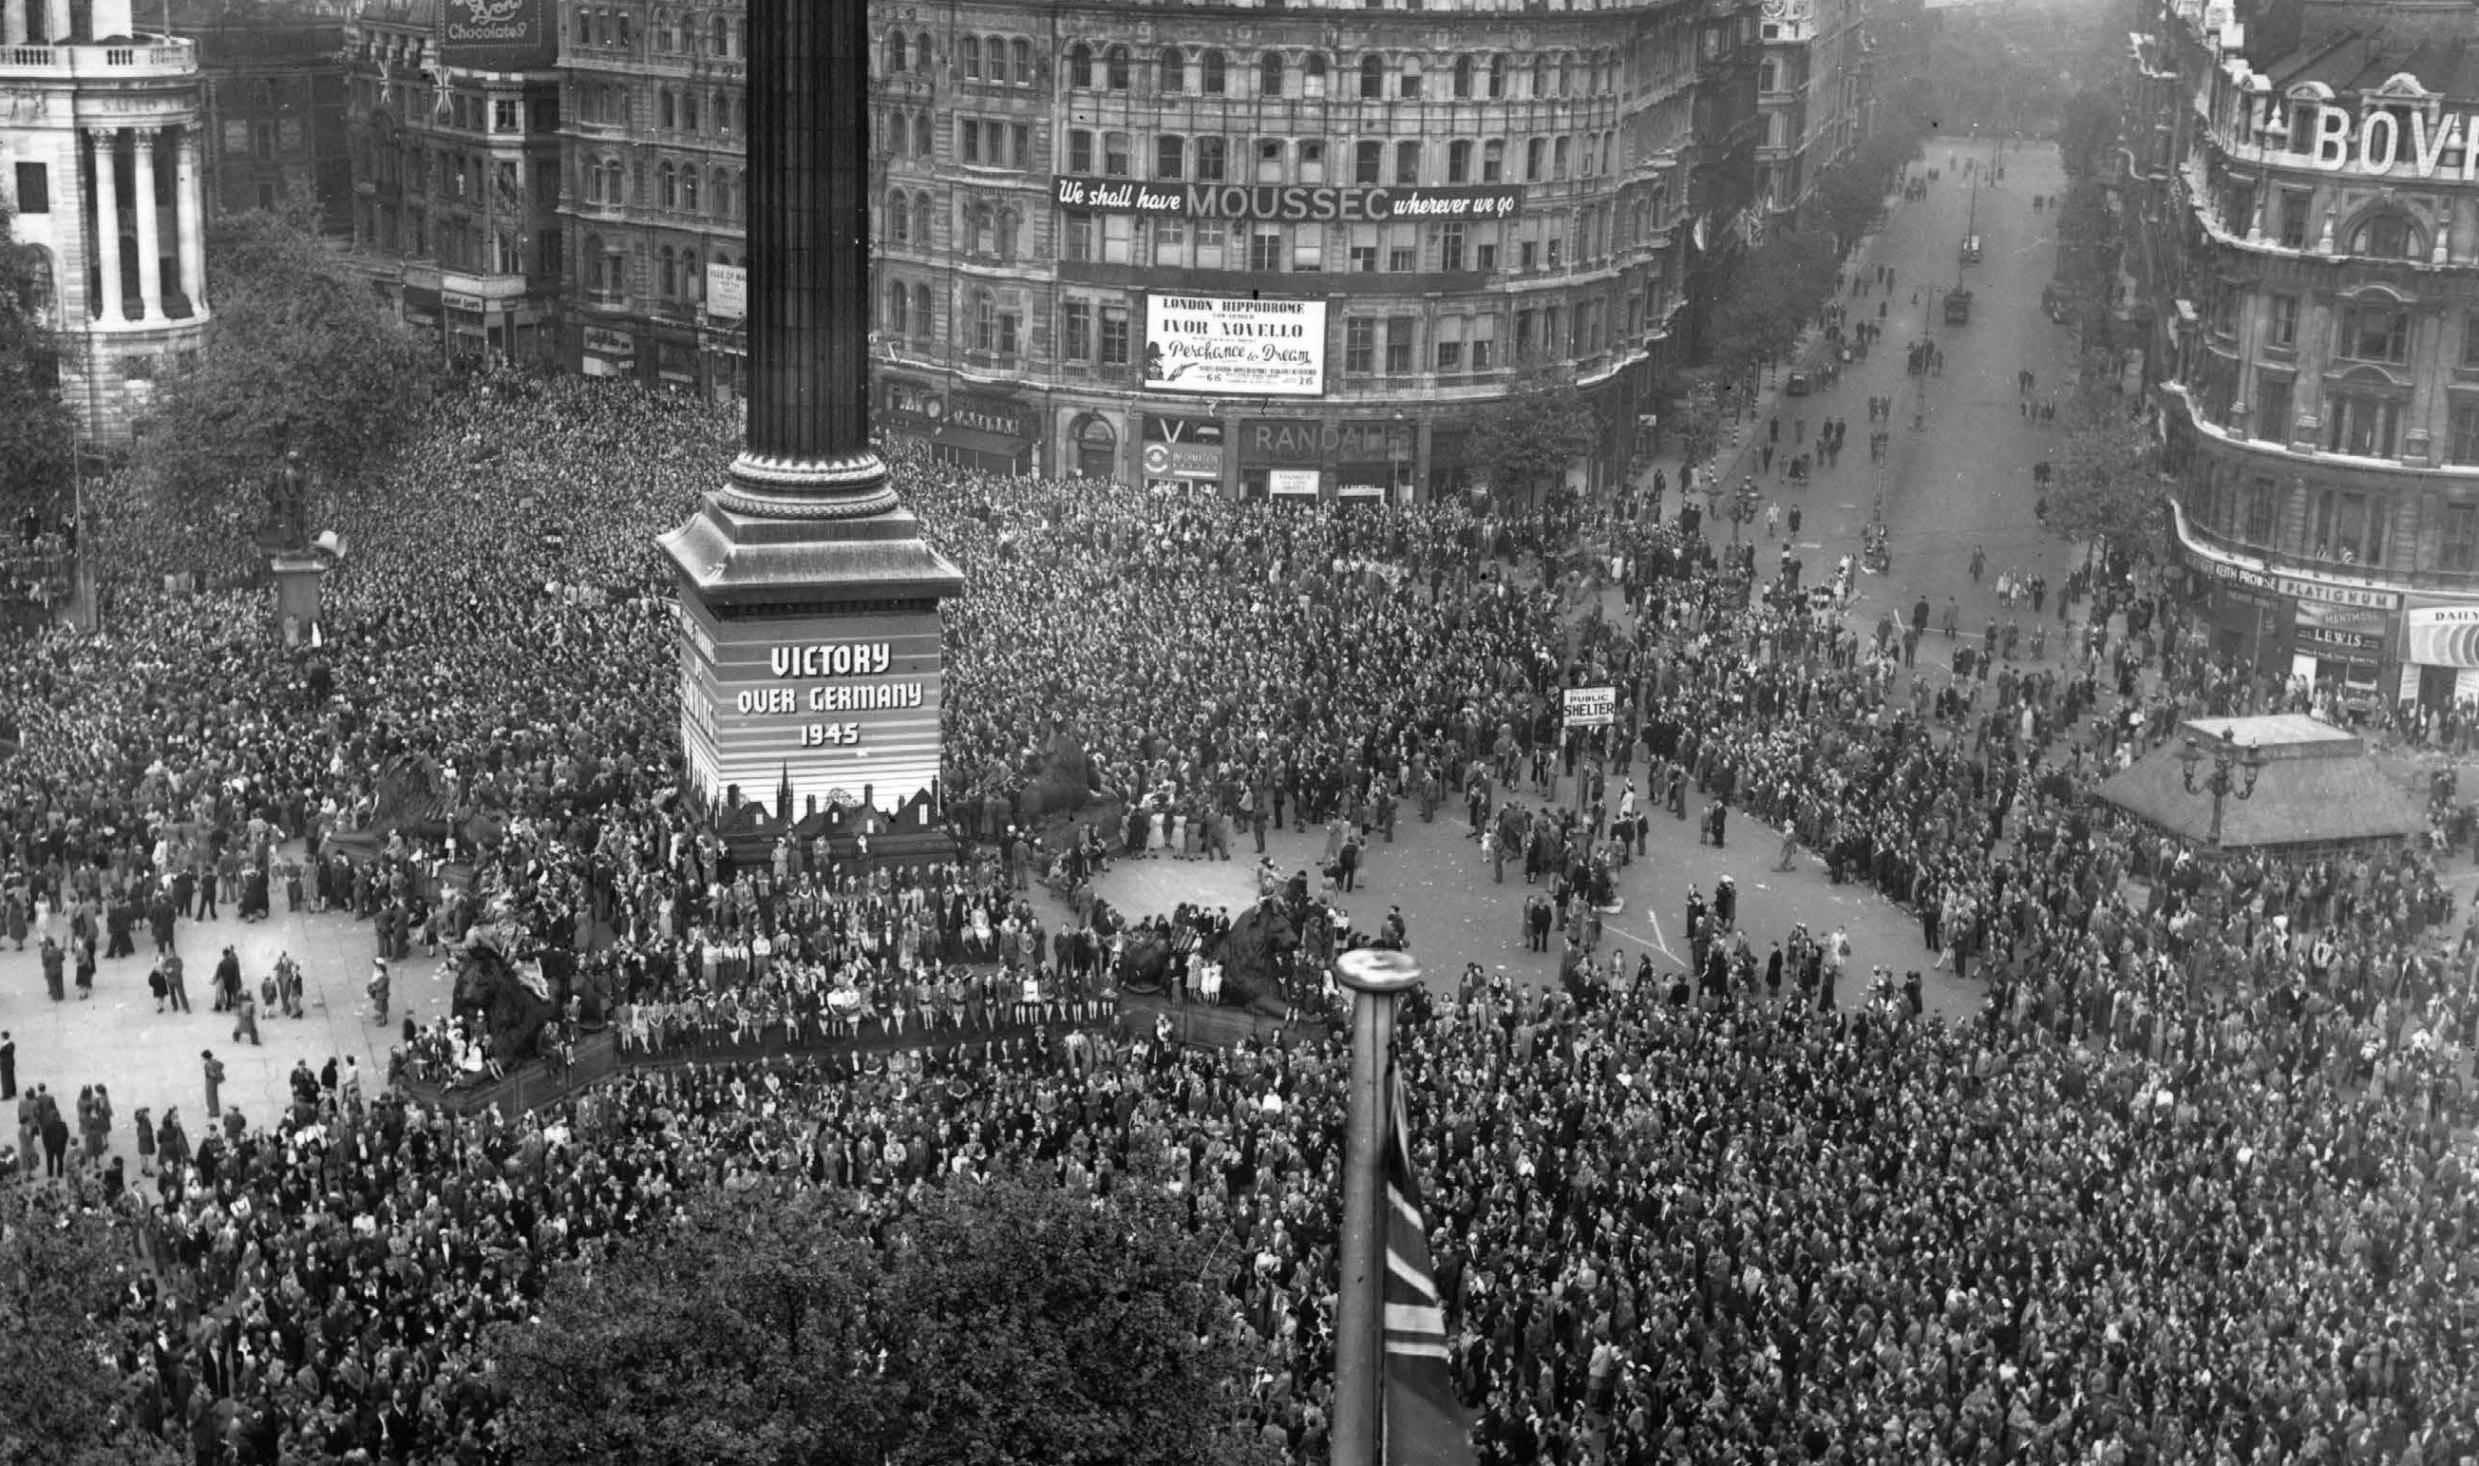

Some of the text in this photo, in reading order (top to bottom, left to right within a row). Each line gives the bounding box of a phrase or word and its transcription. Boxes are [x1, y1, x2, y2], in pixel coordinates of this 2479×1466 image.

[449, 22, 527, 39] Chocolates
[2313, 106, 2479, 180] BOV
[1059, 180, 1514, 221] We shall have MOUSSEC wherever we go
[1163, 298, 1305, 314] LONDON HIPPODROME
[1163, 319, 1304, 338] IVOR NOVELLO
[1168, 340, 1313, 366] Perchance to Dream
[2215, 563, 2237, 581] KEITH
[2287, 582, 2387, 606] PLATIGNUM
[2314, 628, 2362, 647] LEWIS
[771, 643, 891, 676] VICTORY
[737, 683, 923, 714] OVER GERMANY
[1570, 694, 1608, 703] PUBLIC
[1564, 703, 1614, 717] SHELTER
[800, 722, 859, 746] 1945
